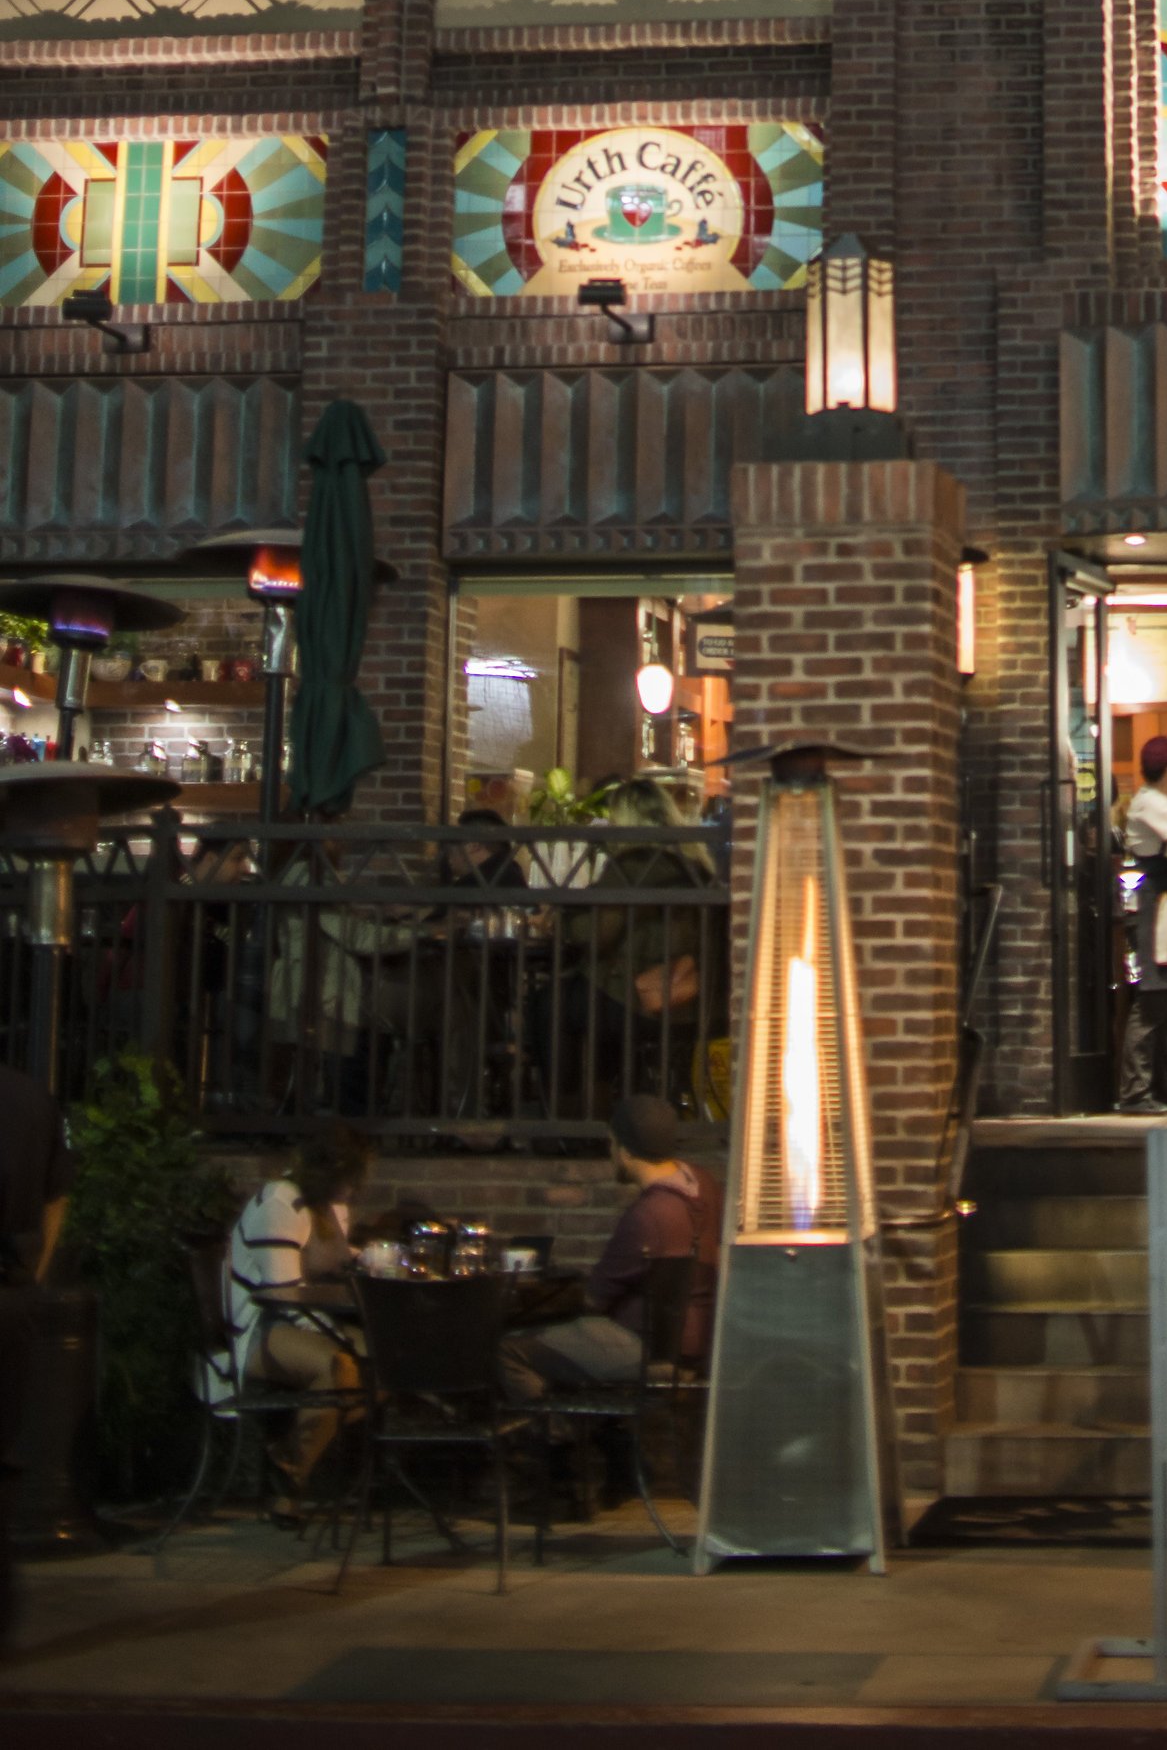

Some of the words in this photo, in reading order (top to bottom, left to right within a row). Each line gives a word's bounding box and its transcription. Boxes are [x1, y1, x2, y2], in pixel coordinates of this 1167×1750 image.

[556, 148, 628, 211] Urth
[636, 141, 725, 210] Caffé
[558, 259, 620, 274] Exclusively
[624, 258, 668, 273] Organic
[643, 276, 668, 290] Teas
